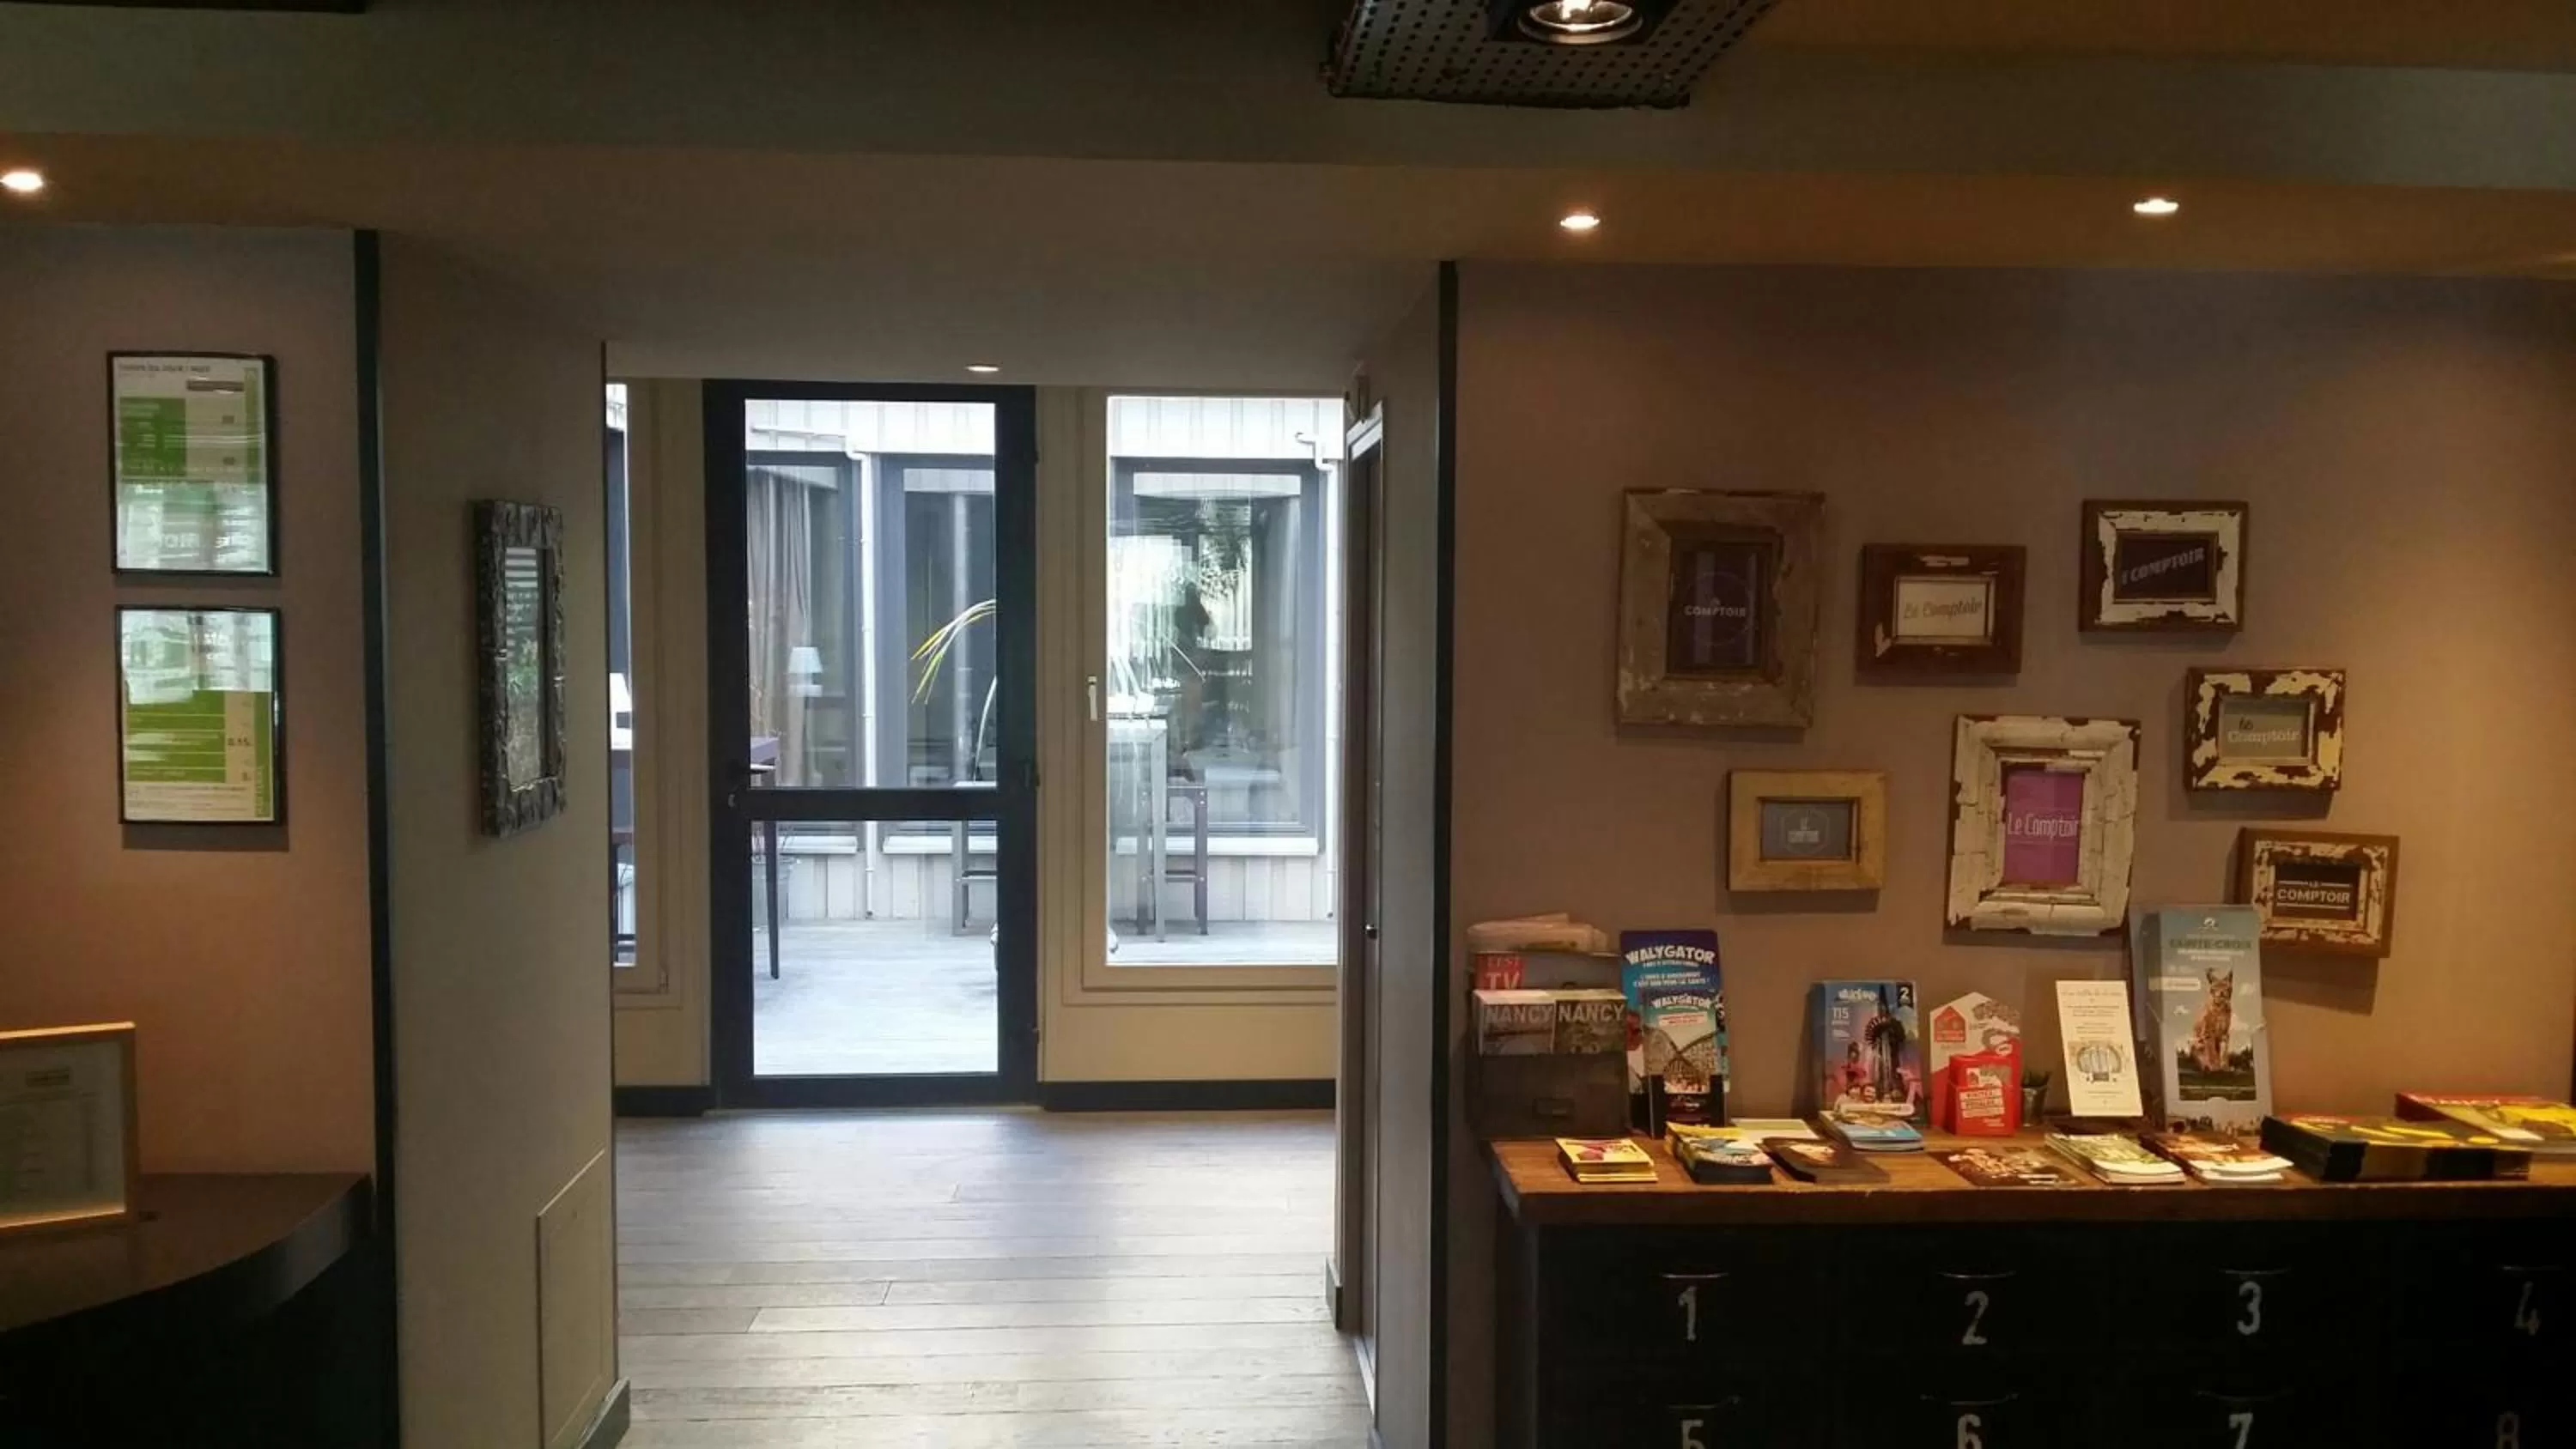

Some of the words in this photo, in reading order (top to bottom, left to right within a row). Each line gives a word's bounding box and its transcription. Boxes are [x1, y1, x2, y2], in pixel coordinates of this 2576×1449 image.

[2129, 547, 2205, 582] COMPTOIR
[2007, 811, 2023, 835] Le
[2277, 888, 2351, 904] COMPTOIR
[1625, 944, 1716, 966] WALYGATOR
[1486, 972, 1520, 990] TV
[1651, 993, 1713, 1009] WALYGATOR
[1899, 986, 1911, 1004] 2
[1485, 1004, 1553, 1025] NANCY
[1558, 1001, 1625, 1023] NANCY
[1677, 1286, 1698, 1343] 1
[1961, 1290, 1990, 1346] 2
[2236, 1281, 2263, 1336] 3
[2513, 1281, 2541, 1337] 4
[2227, 1412, 2254, 1449] 7
